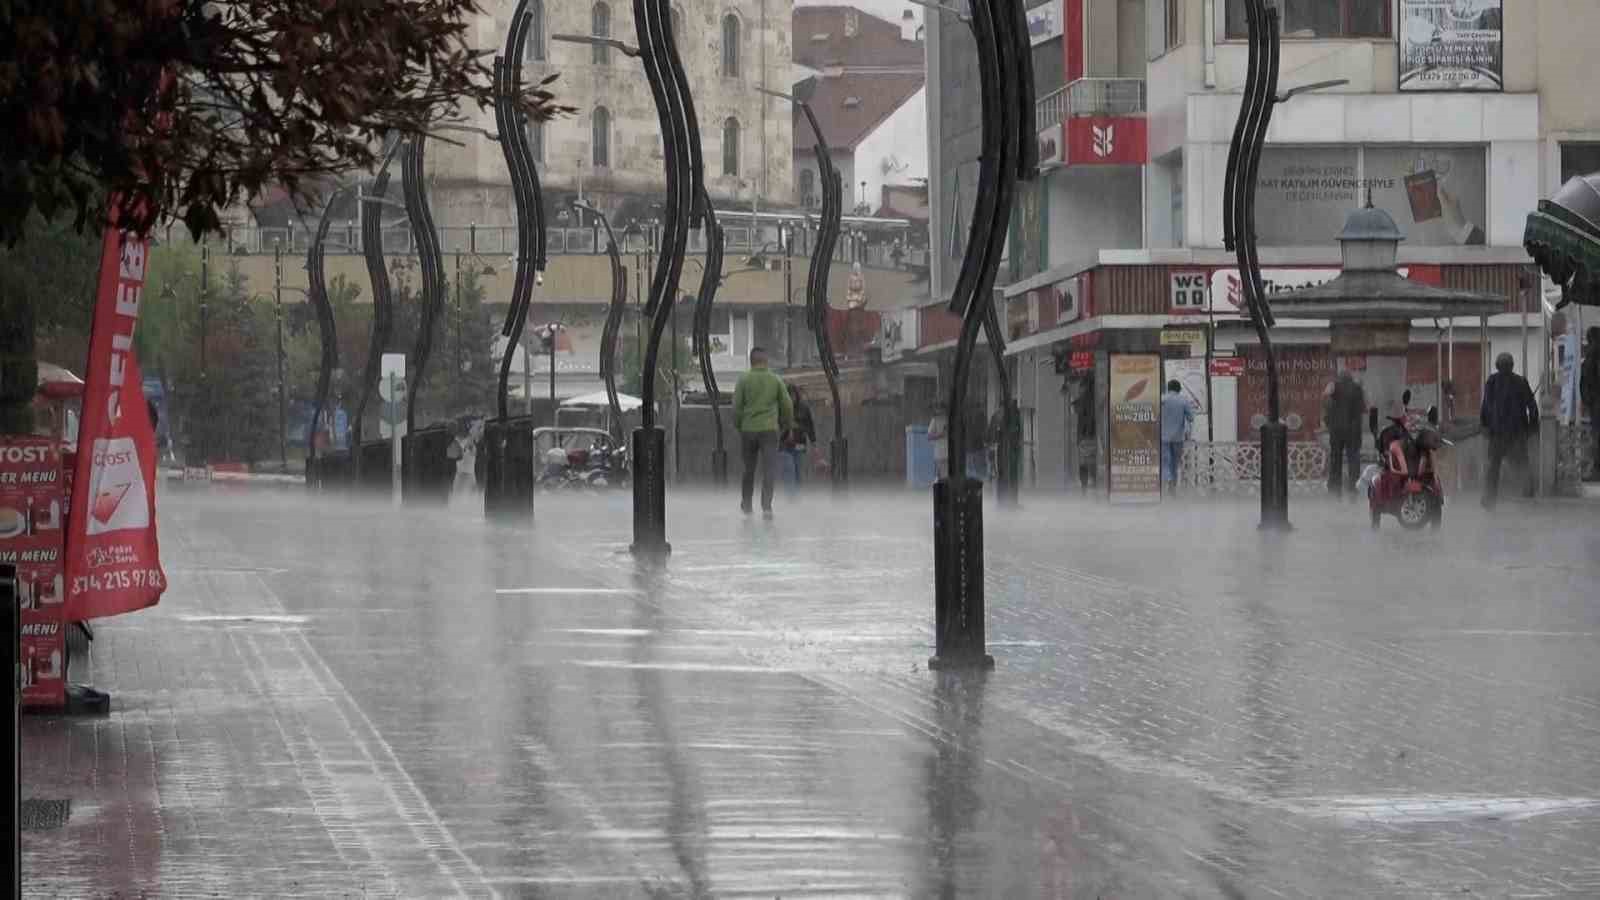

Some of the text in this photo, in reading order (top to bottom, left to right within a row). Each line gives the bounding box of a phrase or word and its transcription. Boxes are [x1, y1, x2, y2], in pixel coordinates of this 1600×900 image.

[1175, 275, 1204, 289] WC
[0, 446, 49, 462] TOST
[72, 574, 102, 595] 374
[103, 569, 130, 591] 215
[132, 568, 146, 589] 97
[22, 620, 59, 635] MENÜ
